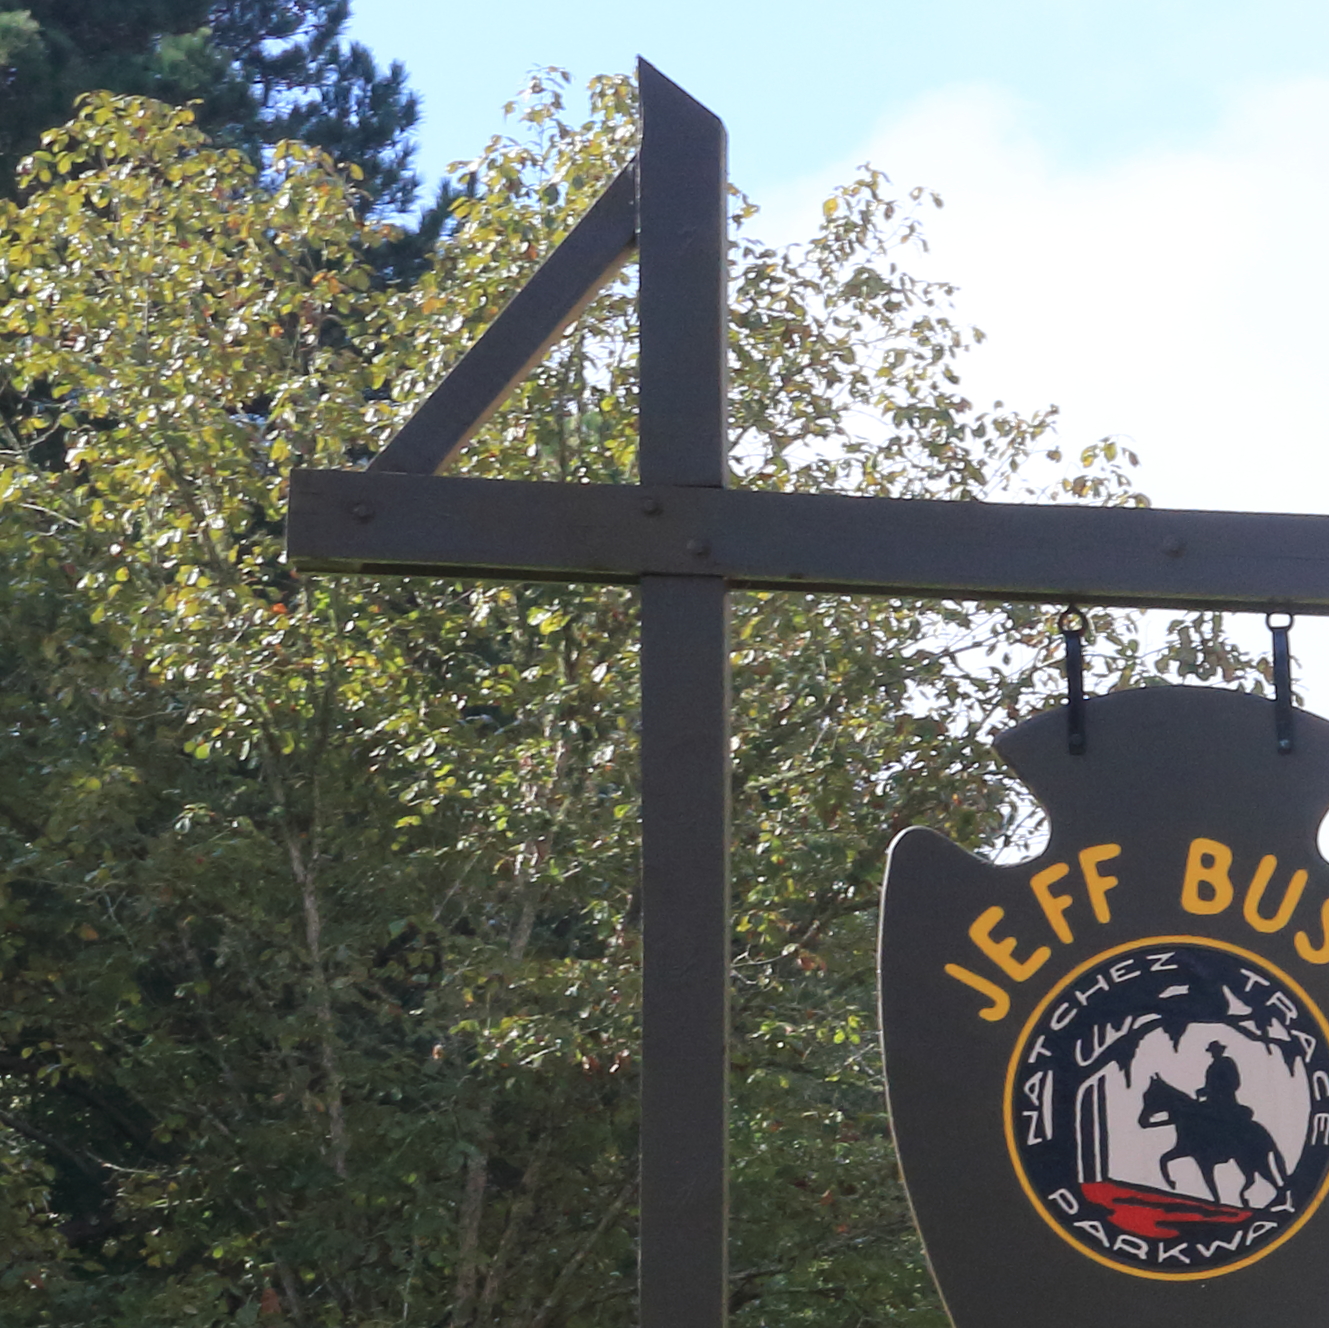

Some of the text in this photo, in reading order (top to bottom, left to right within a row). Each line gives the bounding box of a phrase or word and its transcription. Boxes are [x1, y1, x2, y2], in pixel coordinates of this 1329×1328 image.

[944, 843, 1121, 1022] JEFF
[1022, 951, 1178, 1146] NATCHEZ
[1048, 1188, 1296, 1264] PARKWAY
